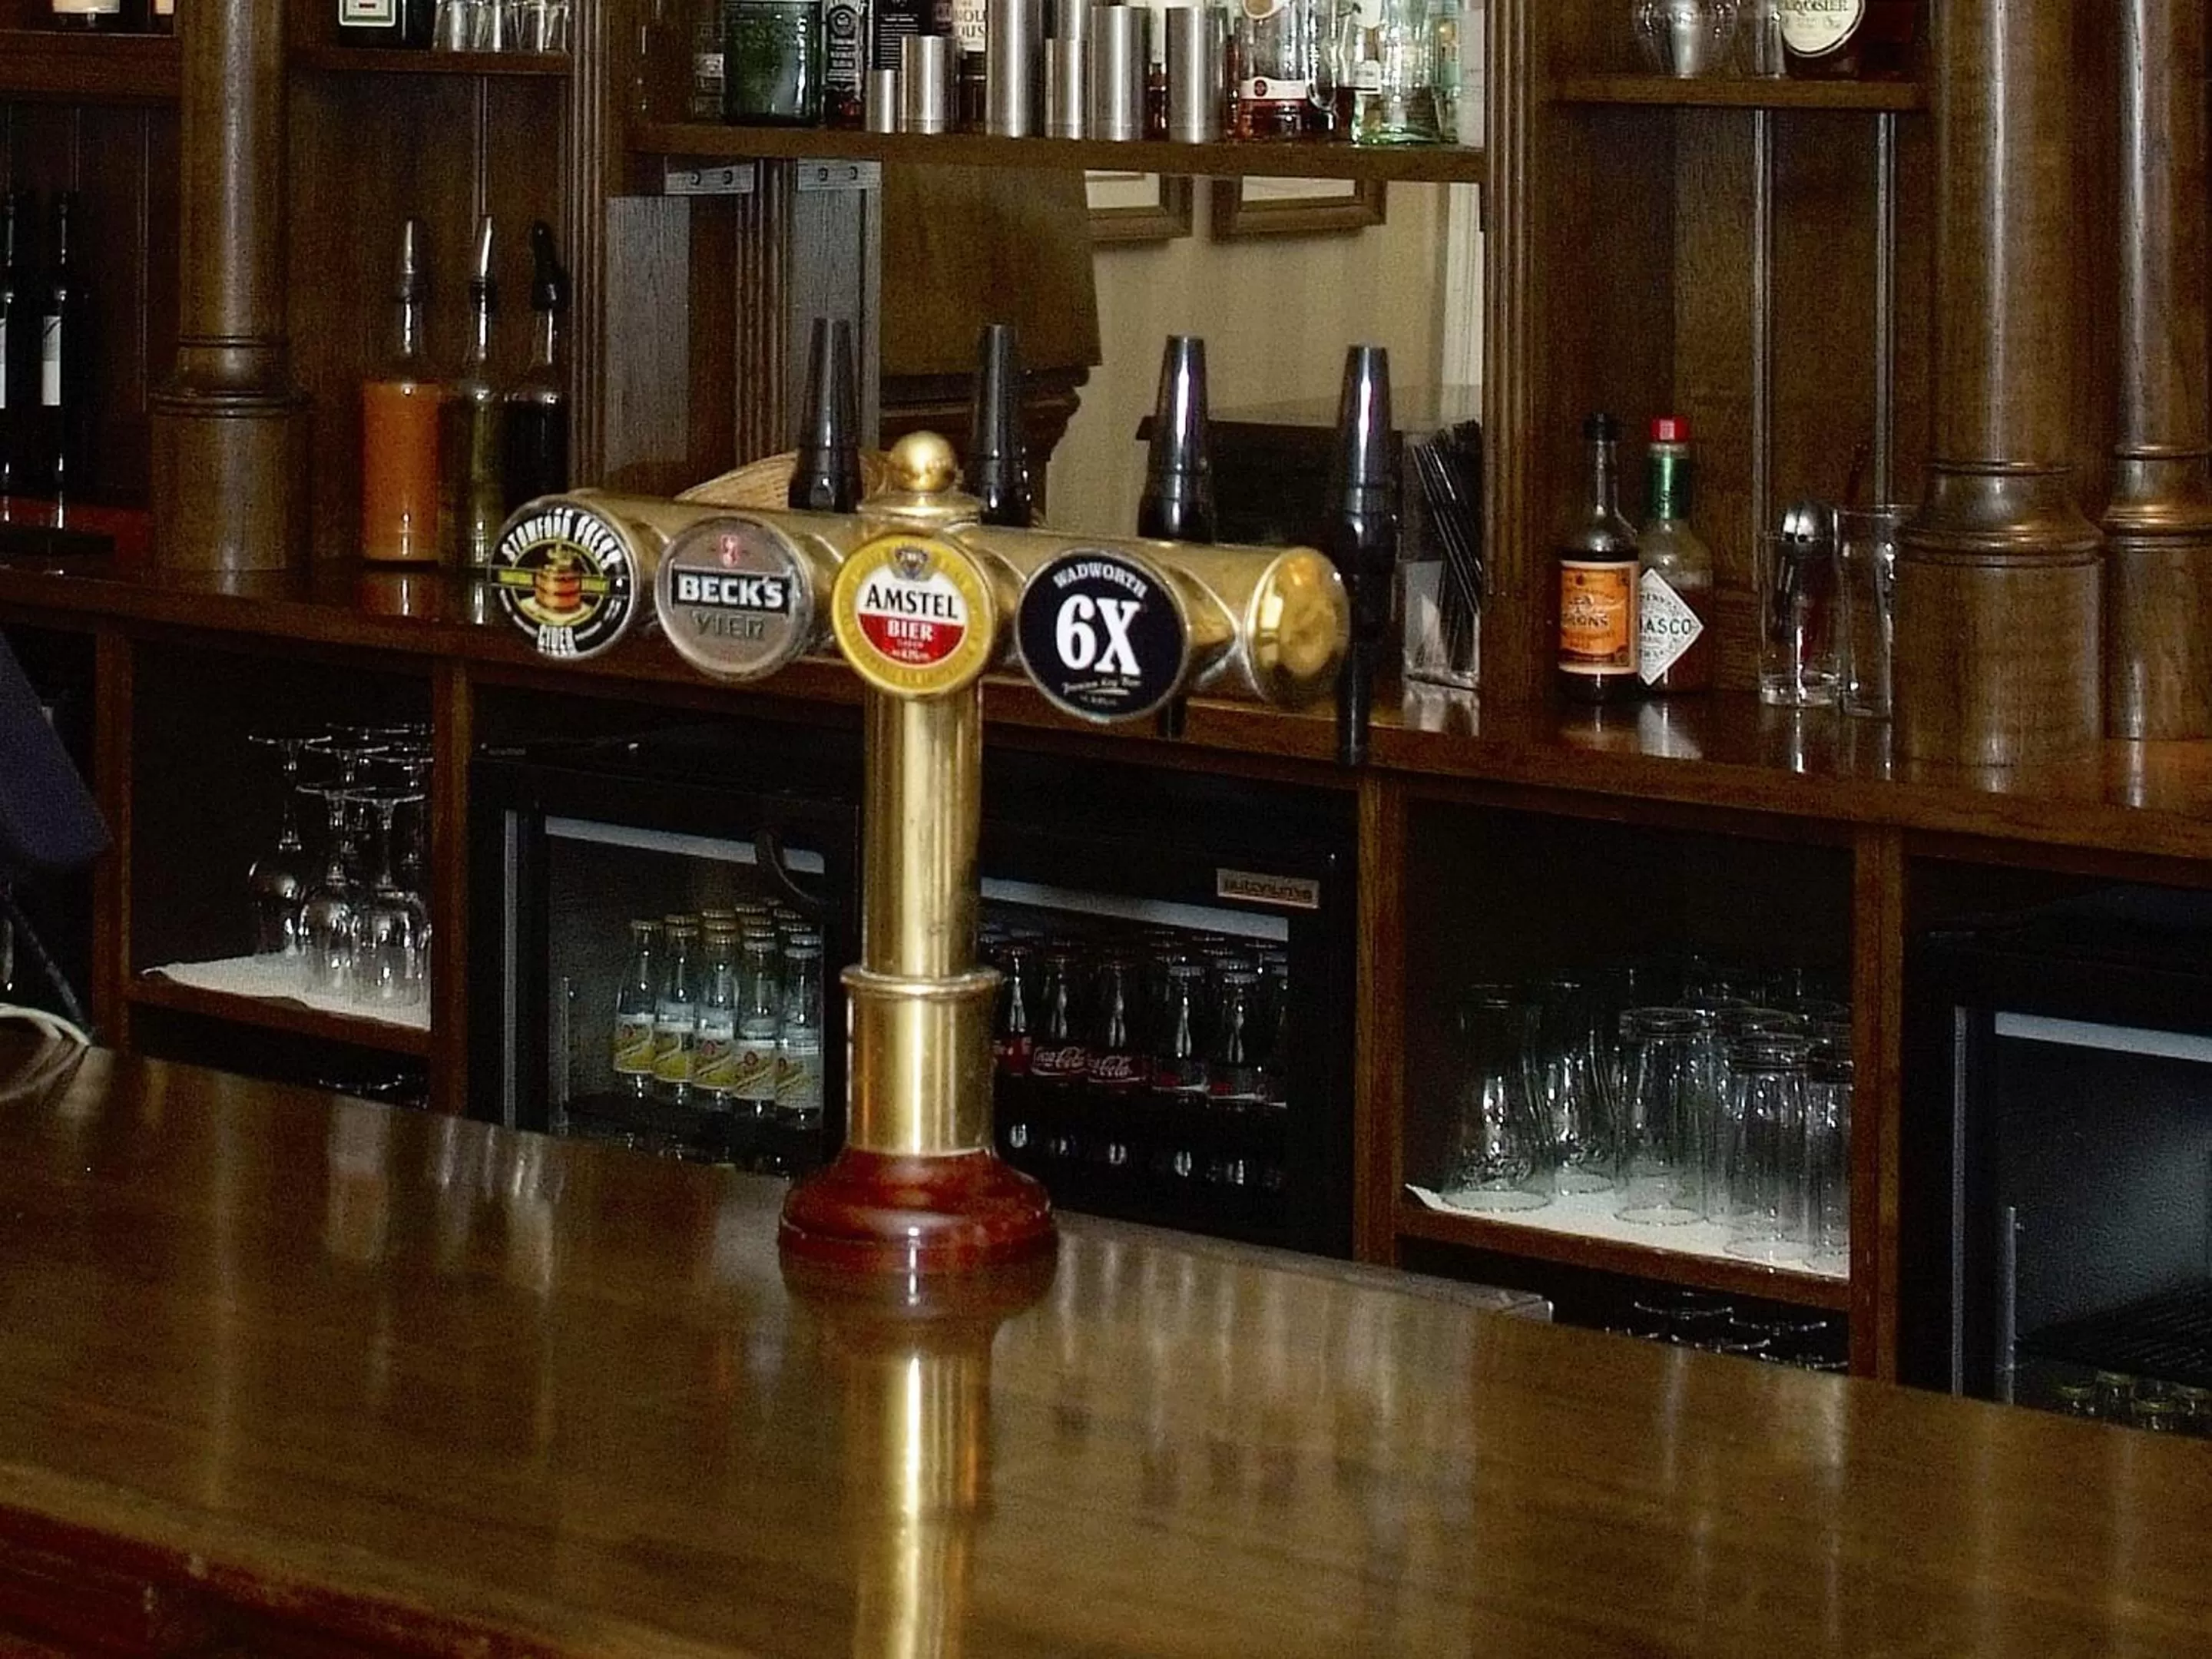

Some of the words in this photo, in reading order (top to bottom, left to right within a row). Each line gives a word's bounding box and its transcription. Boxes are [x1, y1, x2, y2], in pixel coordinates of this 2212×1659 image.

[502, 507, 574, 562] STOWFORD
[574, 515, 622, 570] PRESS
[677, 572, 783, 609] BECK'S
[1053, 561, 1149, 599] WADWORTH
[865, 582, 959, 619] AMSTEL
[537, 624, 577, 657] CIDER
[692, 611, 766, 641] VIER
[886, 619, 934, 642] BIER
[1055, 593, 1141, 676] 6X
[1640, 615, 1692, 635] ASCO
